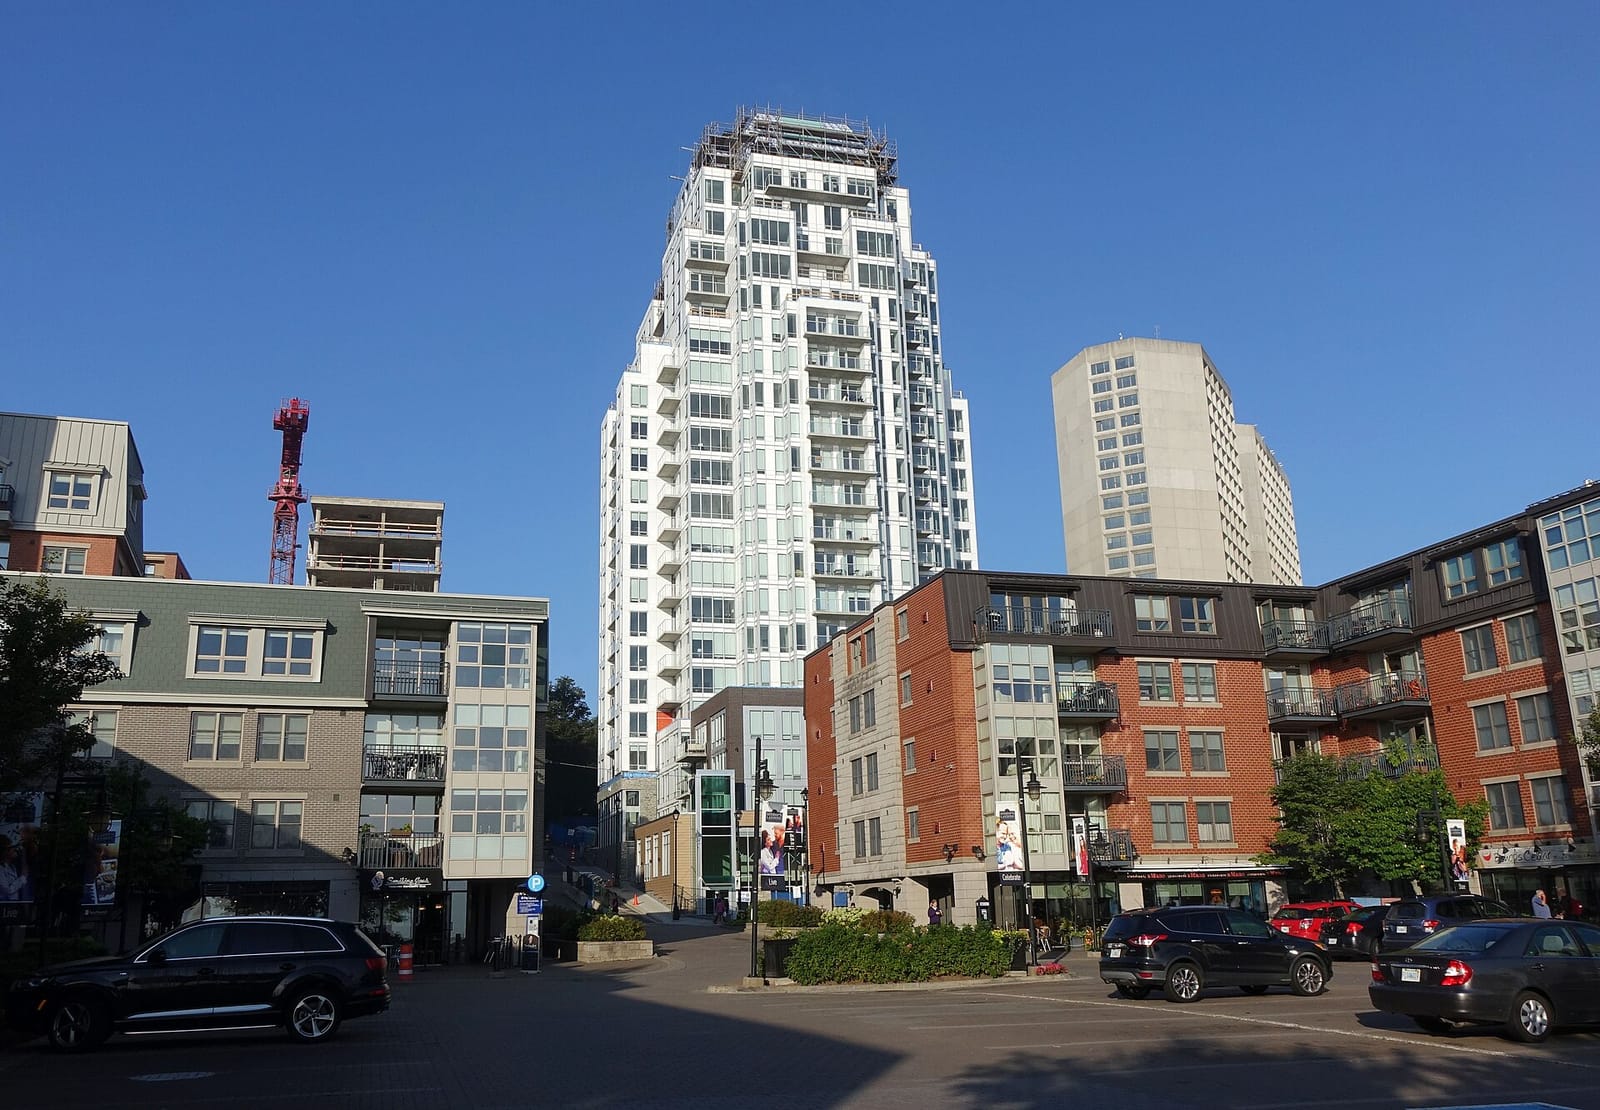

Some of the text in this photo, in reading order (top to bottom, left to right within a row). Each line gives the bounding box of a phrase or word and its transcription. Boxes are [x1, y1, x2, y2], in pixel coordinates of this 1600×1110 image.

[768, 877, 778, 886] Live
[1002, 873, 1021, 881] Celebrate
[532, 878, 541, 889] P
